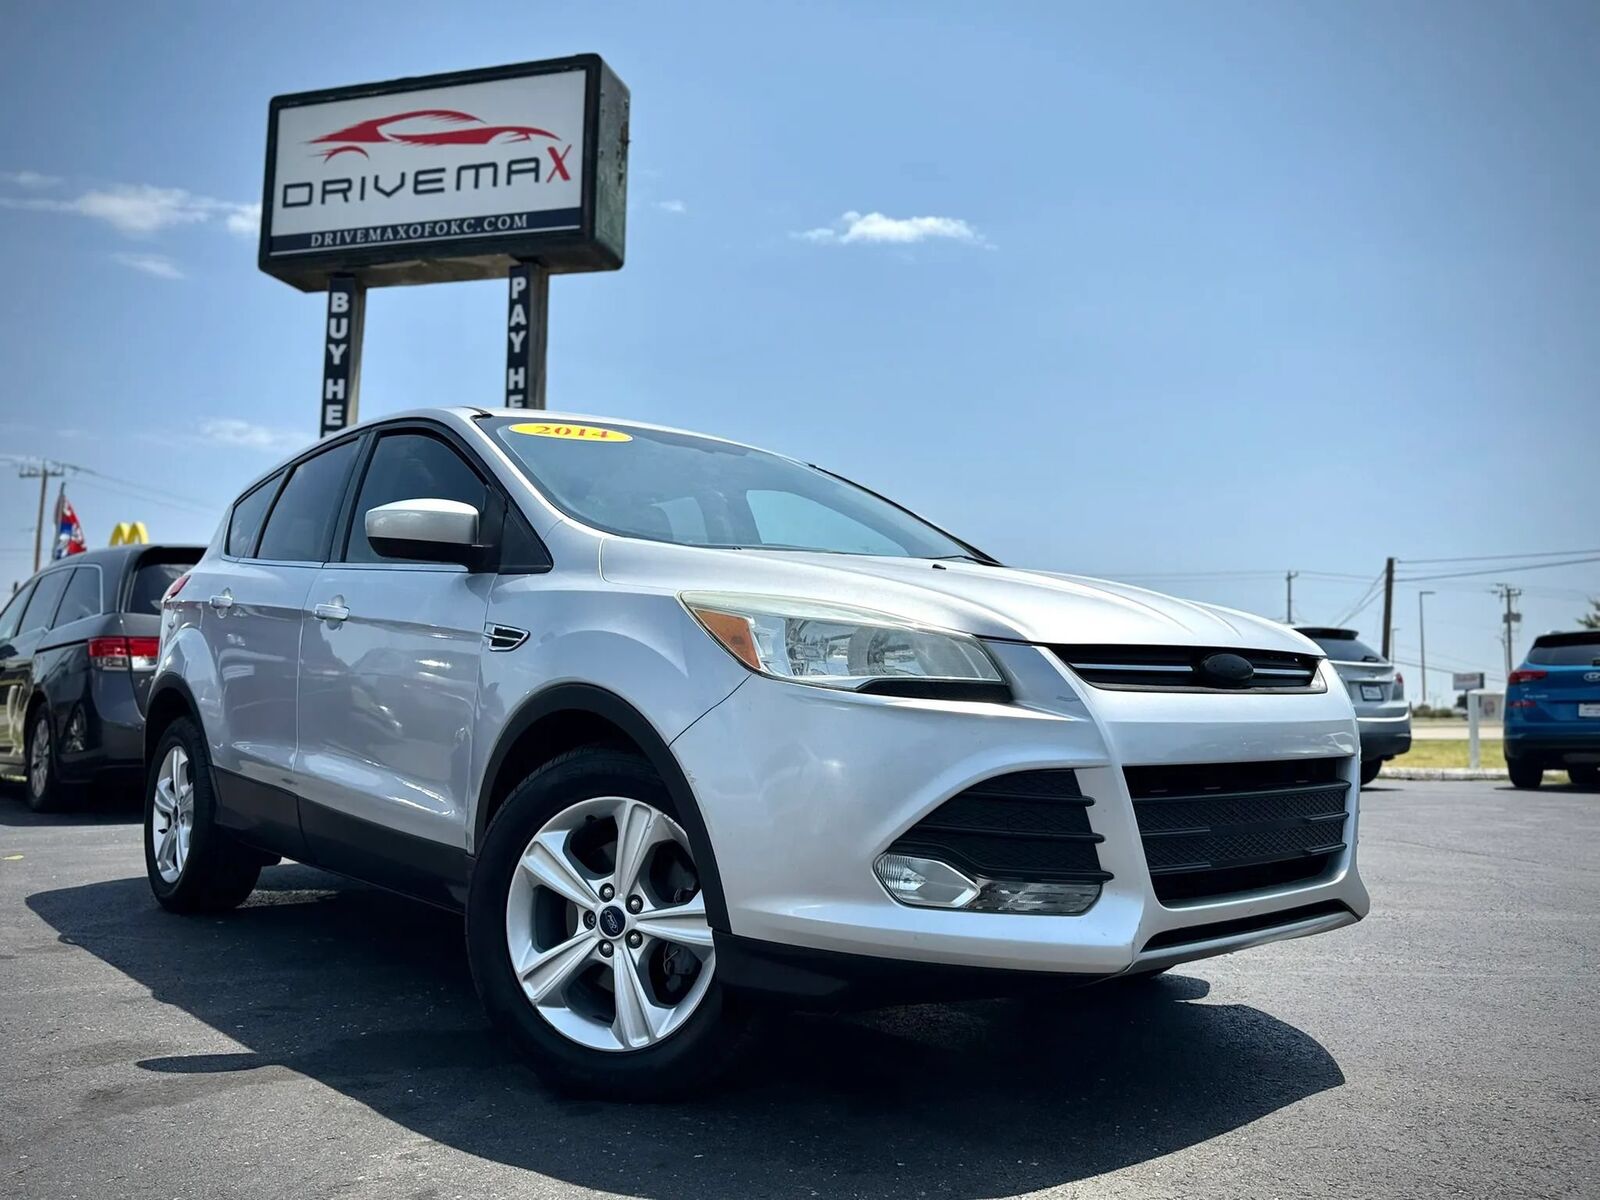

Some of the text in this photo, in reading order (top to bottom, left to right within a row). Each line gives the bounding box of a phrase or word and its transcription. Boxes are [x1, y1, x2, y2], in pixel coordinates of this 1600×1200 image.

[282, 144, 572, 208] DRIVEMAX
[311, 214, 528, 247] DRIVEMAXOFOKC.COM
[509, 276, 527, 353] PAY
[324, 292, 349, 436] BUY HE
[536, 425, 608, 439] 2014
